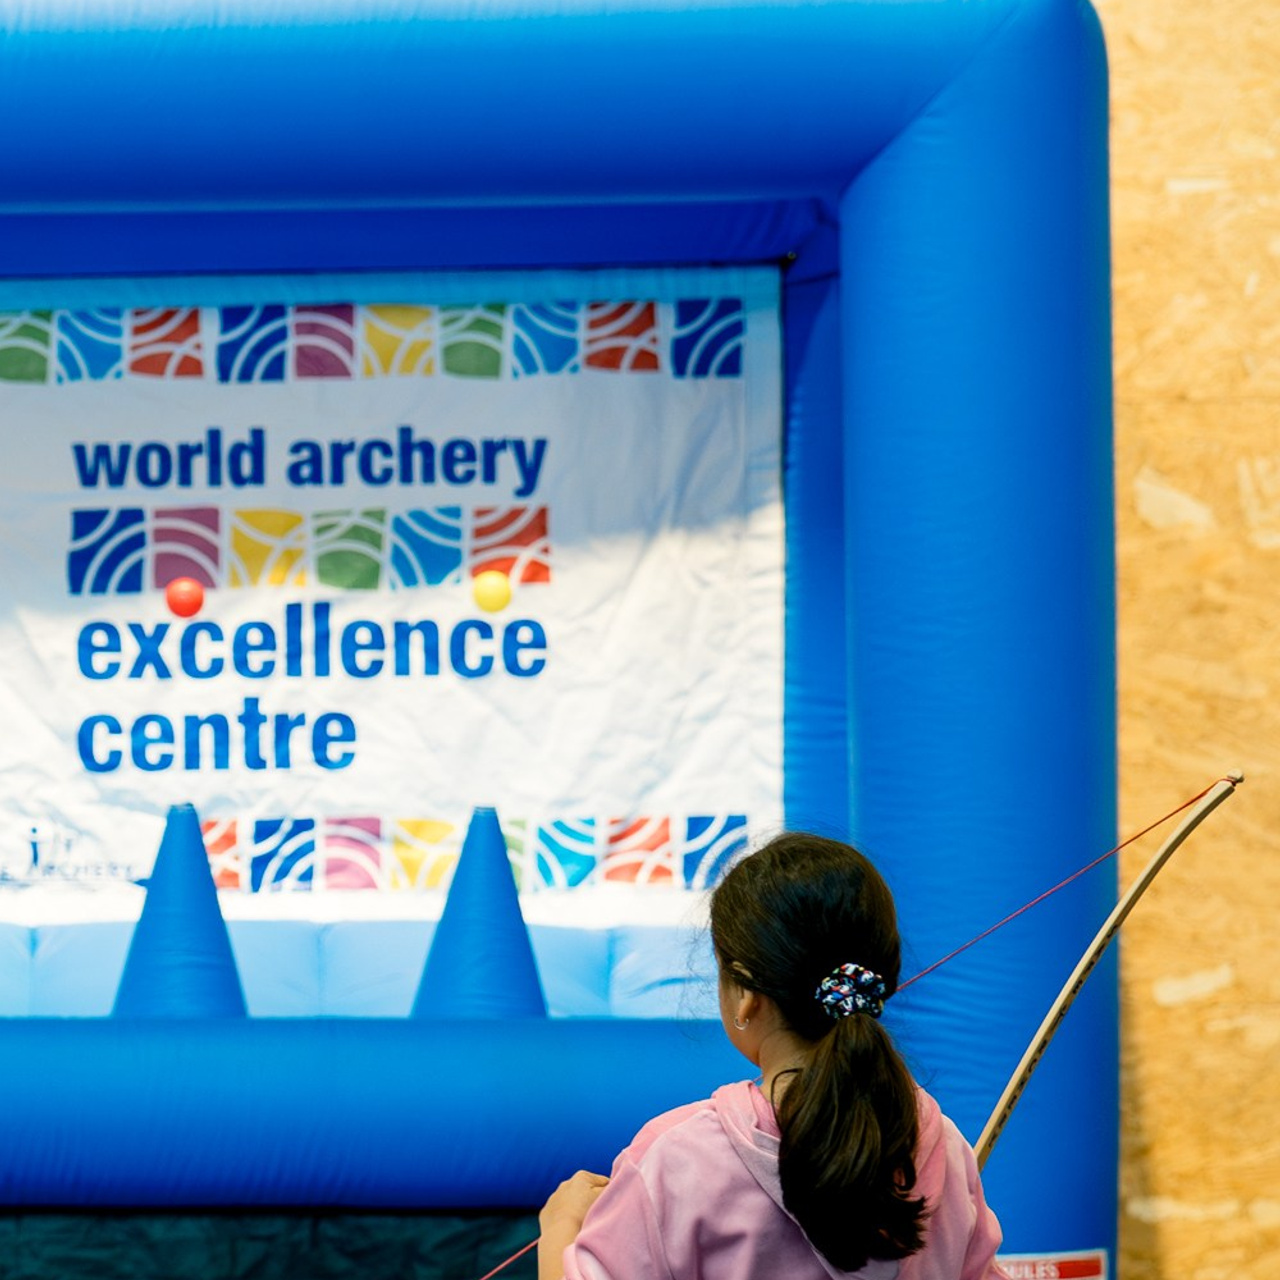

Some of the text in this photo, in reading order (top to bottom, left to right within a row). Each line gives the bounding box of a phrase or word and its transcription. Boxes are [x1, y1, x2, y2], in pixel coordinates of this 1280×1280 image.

[72, 424, 549, 500] world archery
[77, 601, 548, 680] excellence
[76, 696, 357, 774] centre
